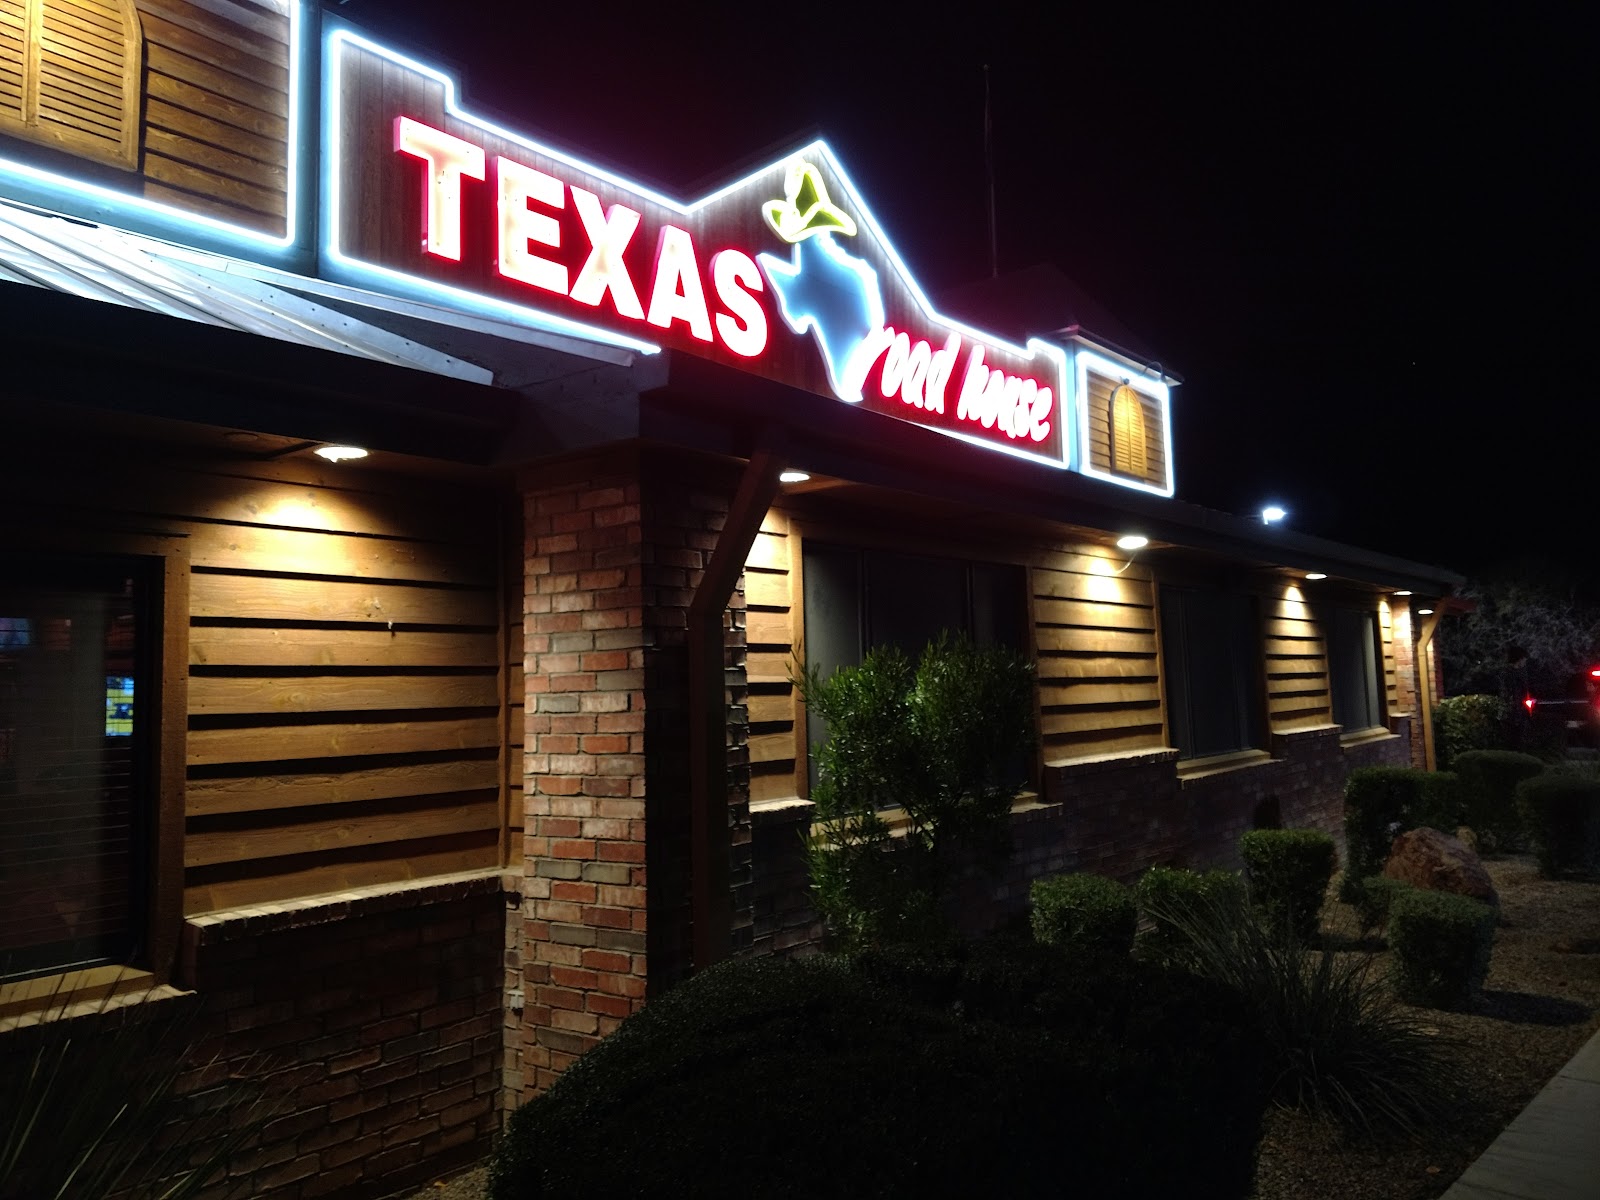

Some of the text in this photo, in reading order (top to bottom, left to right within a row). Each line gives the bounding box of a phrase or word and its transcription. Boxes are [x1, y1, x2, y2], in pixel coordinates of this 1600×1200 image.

[393, 115, 768, 358] TEXAS
[856, 326, 1053, 442] road house
